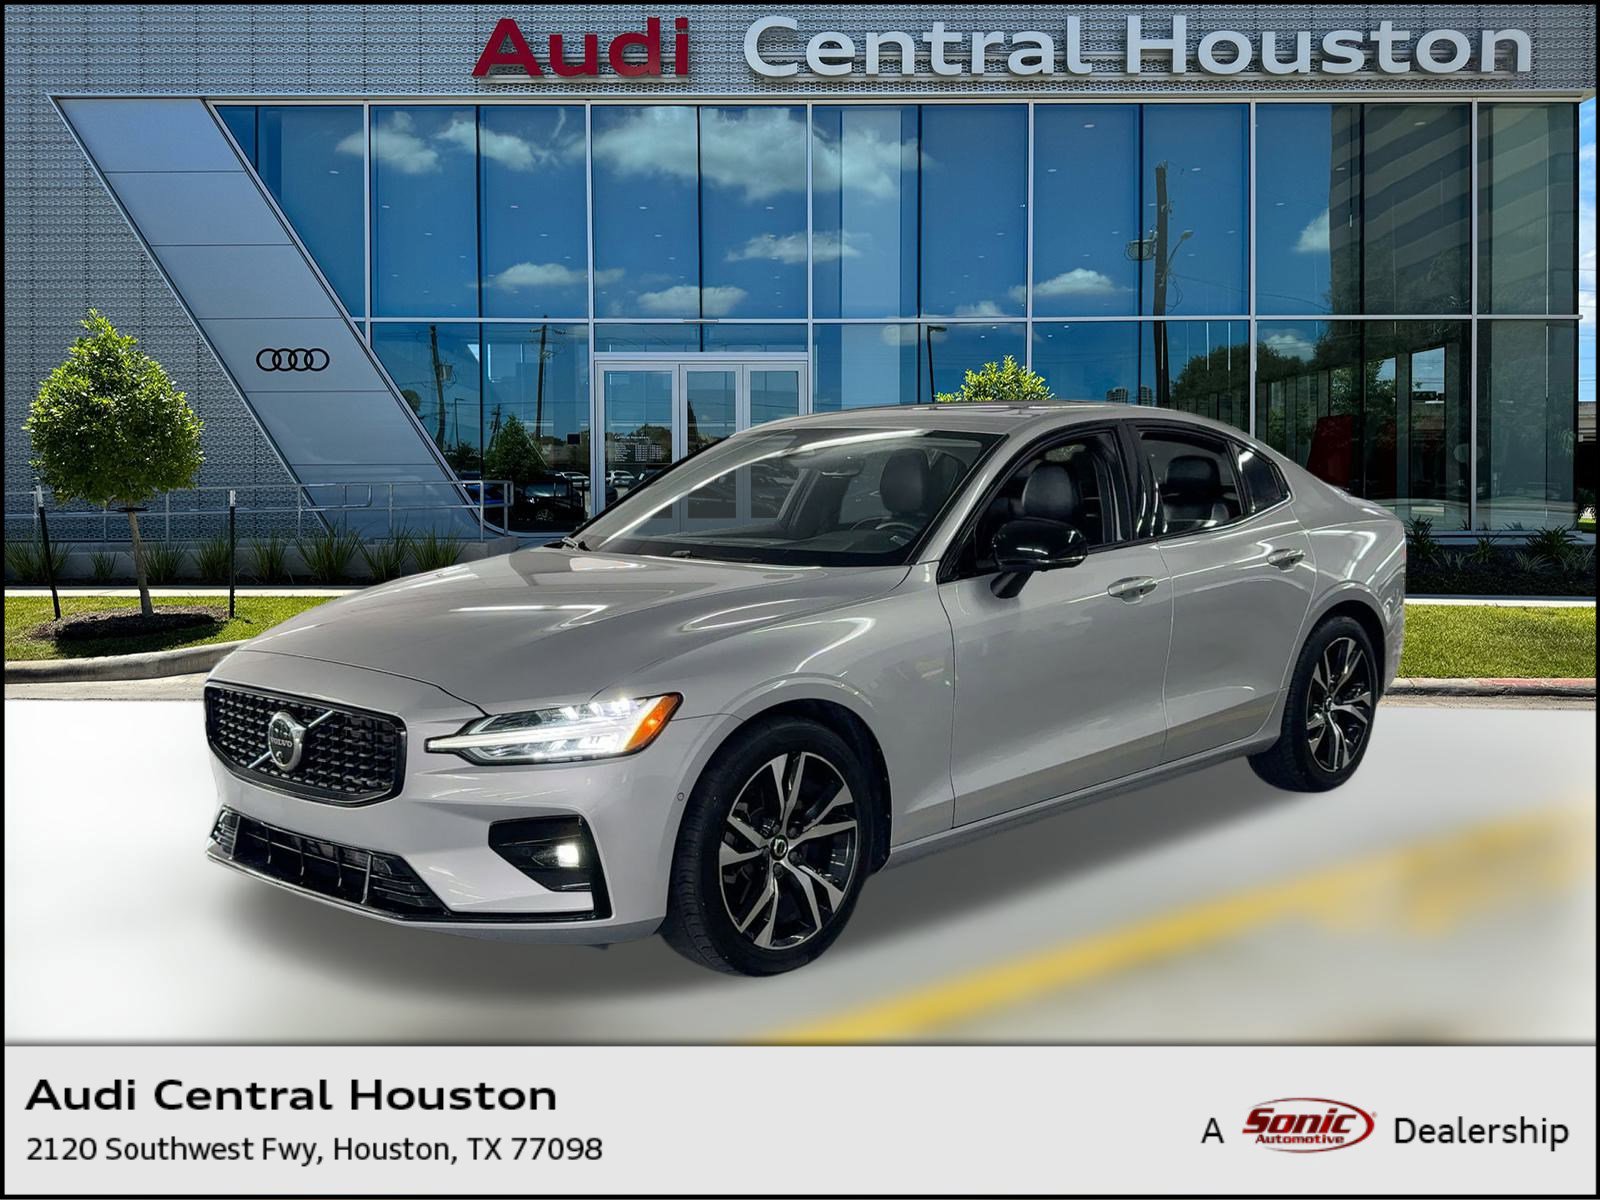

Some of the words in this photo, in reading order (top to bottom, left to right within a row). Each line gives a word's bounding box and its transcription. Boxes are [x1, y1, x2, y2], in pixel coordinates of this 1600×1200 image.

[471, 16, 688, 78] Audi
[744, 15, 1093, 77] Central
[1127, 14, 1532, 75] Houston
[271, 737, 293, 748] VOLVO
